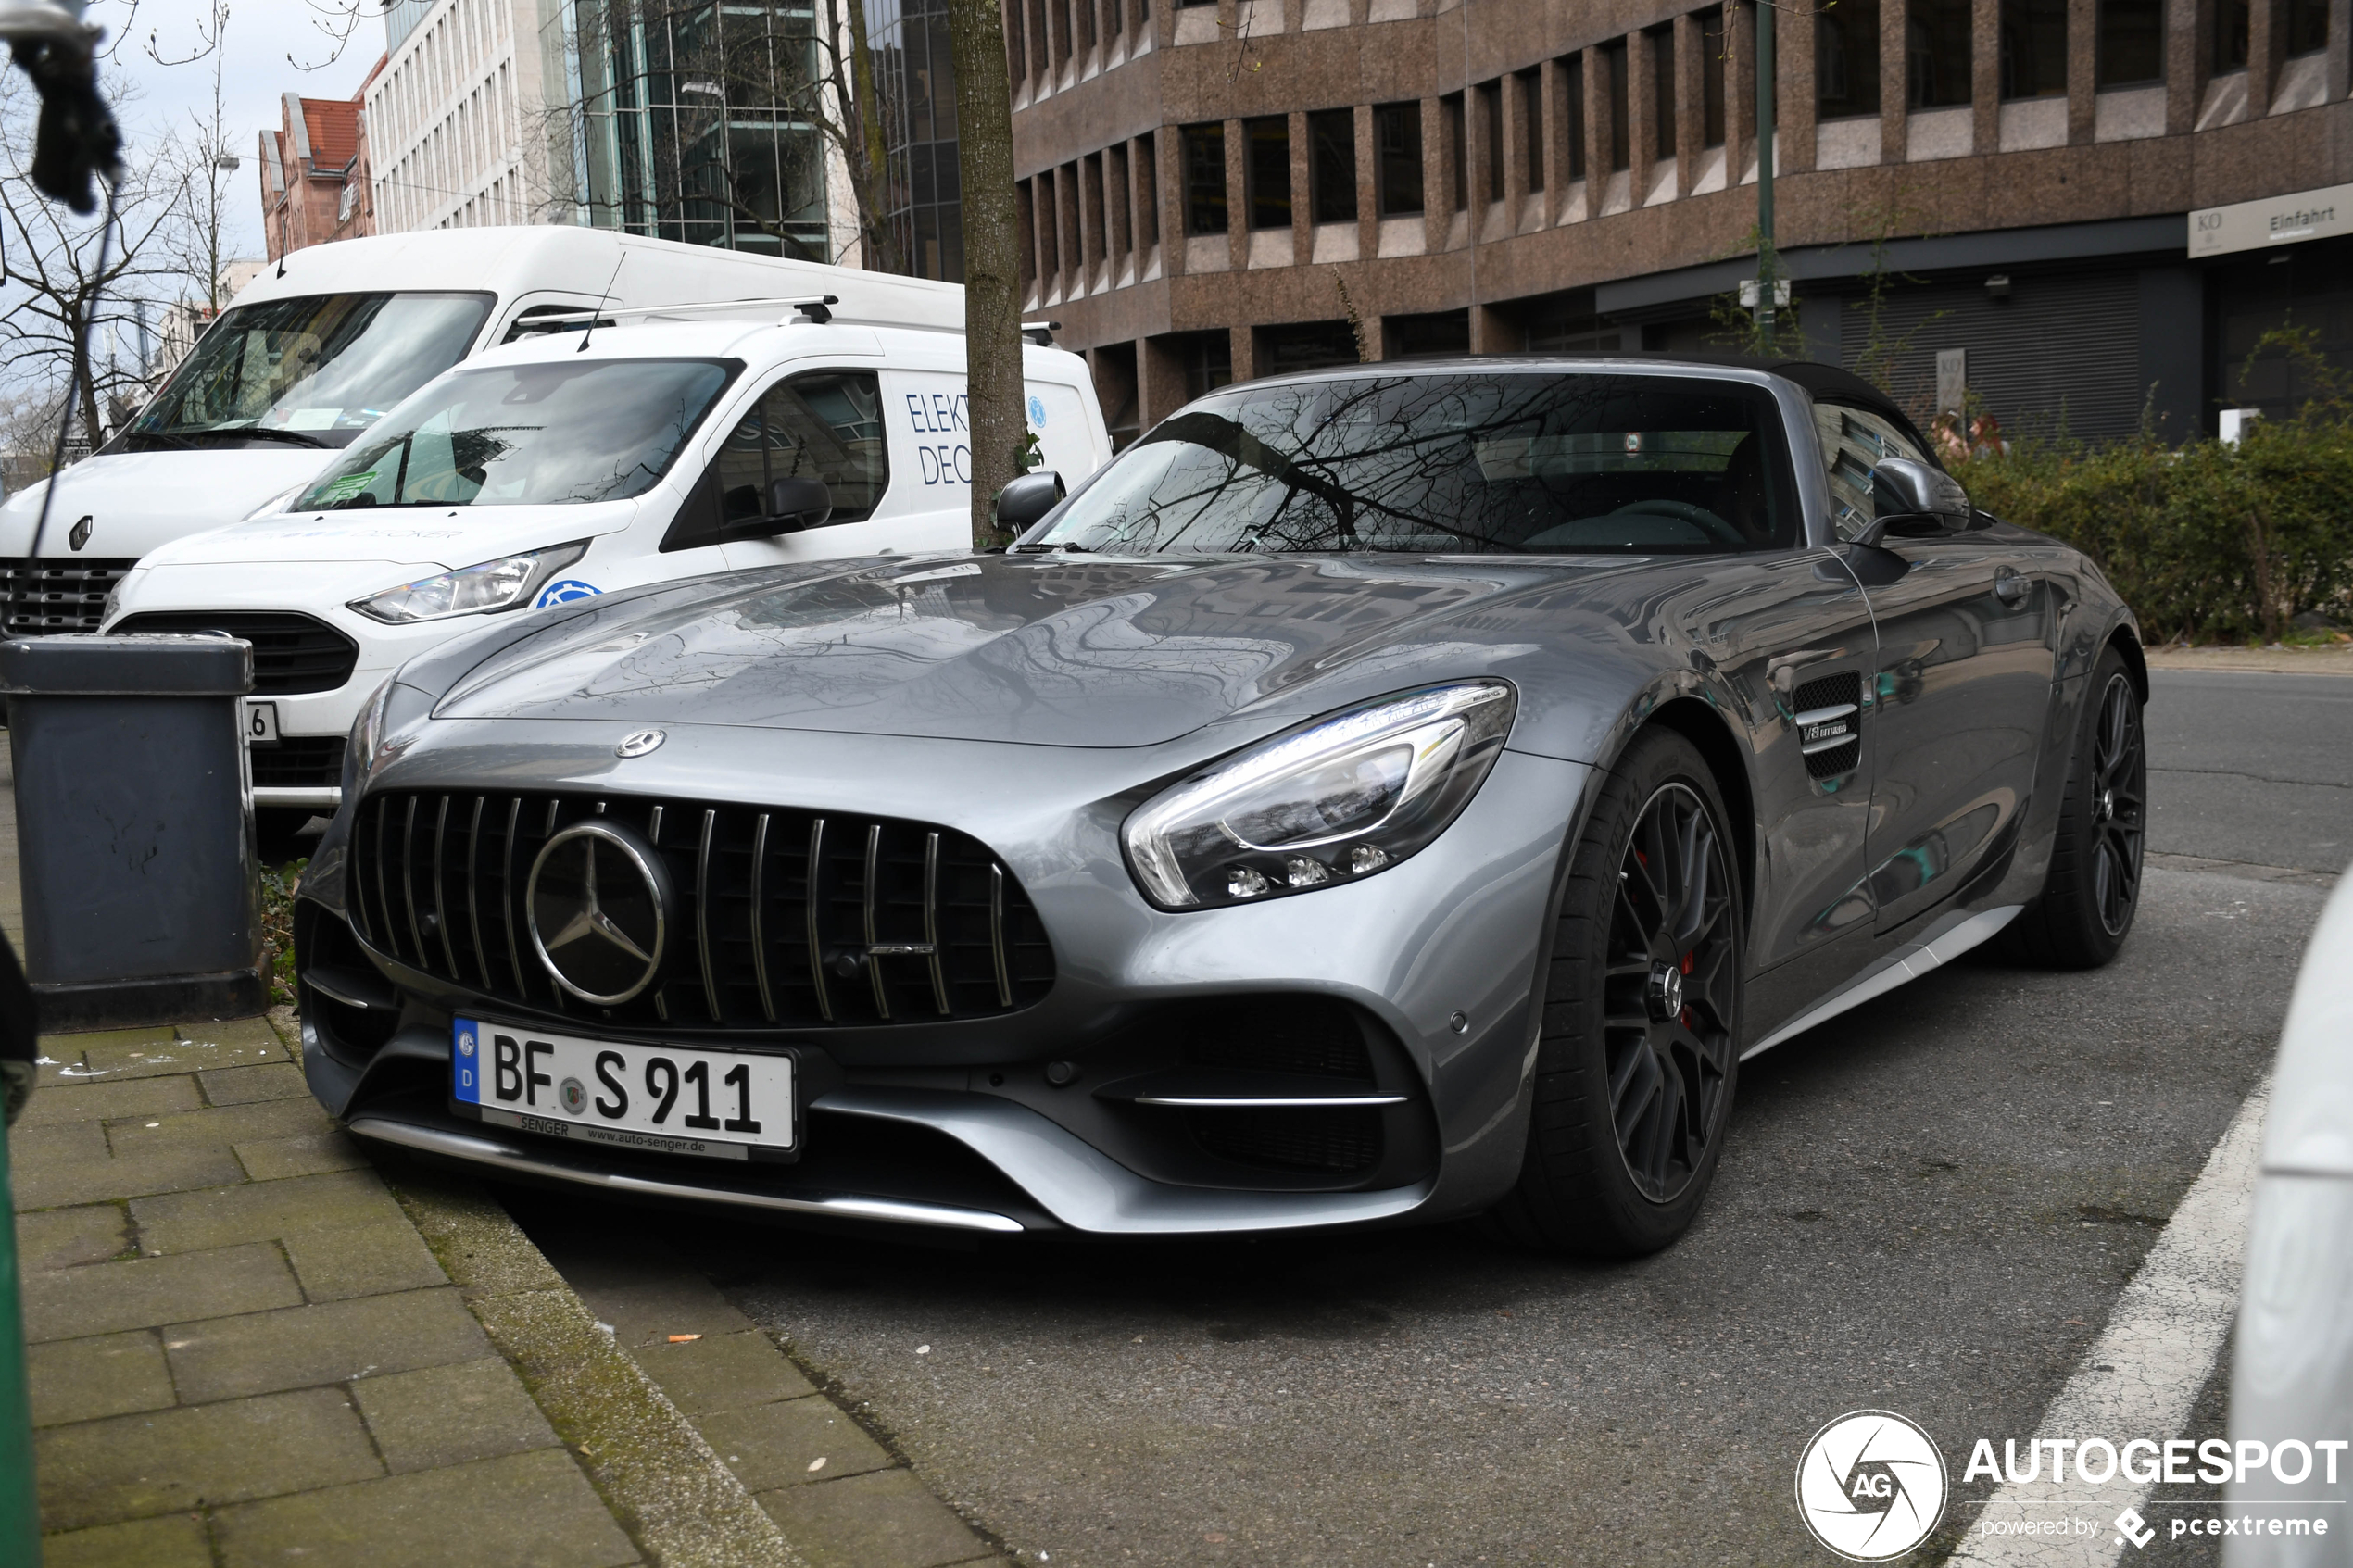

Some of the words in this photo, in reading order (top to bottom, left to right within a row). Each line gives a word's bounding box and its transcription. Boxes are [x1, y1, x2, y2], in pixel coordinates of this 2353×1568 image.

[2269, 206, 2335, 232] Einfahrt
[461, 1069, 472, 1088] D
[494, 1034, 555, 1107] BF
[594, 1049, 629, 1120] S
[645, 1056, 762, 1135] 911
[521, 1116, 569, 1137] SENGER
[587, 1129, 706, 1152] www.auto-senger.de
